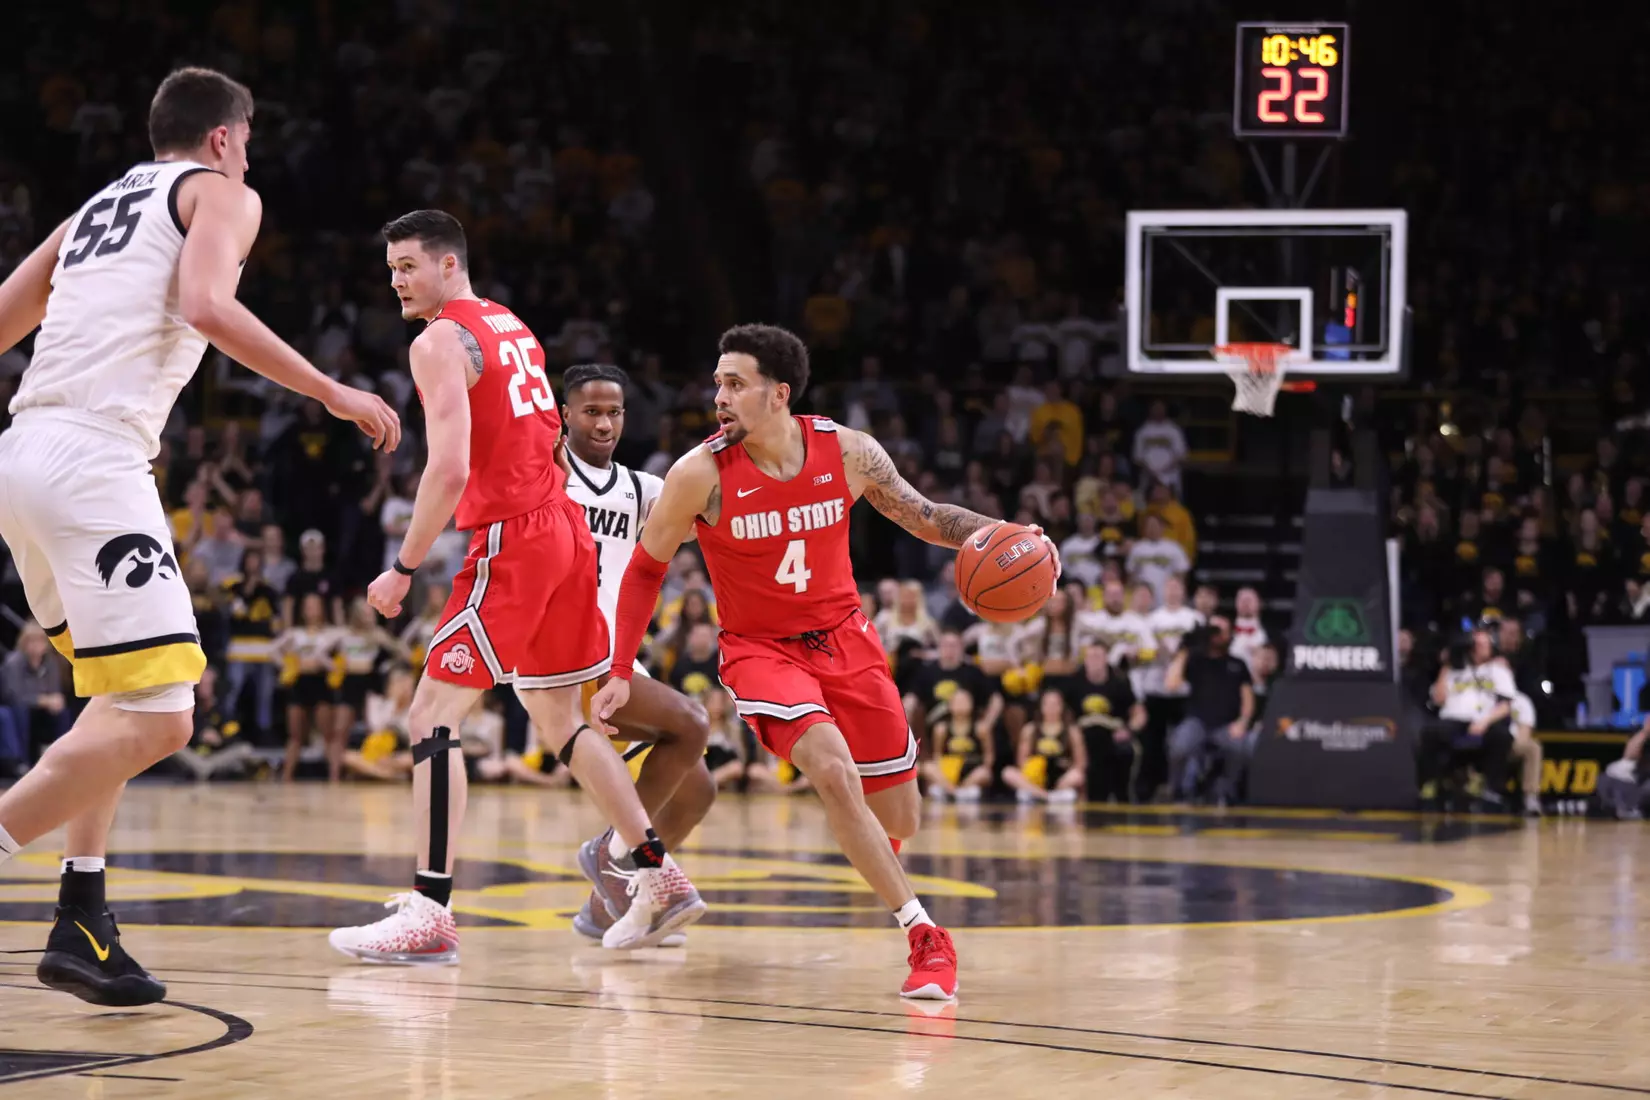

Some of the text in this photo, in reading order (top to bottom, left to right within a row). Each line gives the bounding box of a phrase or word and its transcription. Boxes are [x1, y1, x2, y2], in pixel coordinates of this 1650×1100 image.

[1262, 34, 1338, 66] 10:46
[1257, 67, 1329, 122] 22
[63, 188, 156, 269] 55
[499, 336, 554, 418] 25
[580, 503, 630, 540] WA
[730, 497, 845, 540] OHIO STATE
[774, 539, 812, 594] 4
[1293, 645, 1380, 671] PIONEER
[1540, 759, 1600, 793] ND
